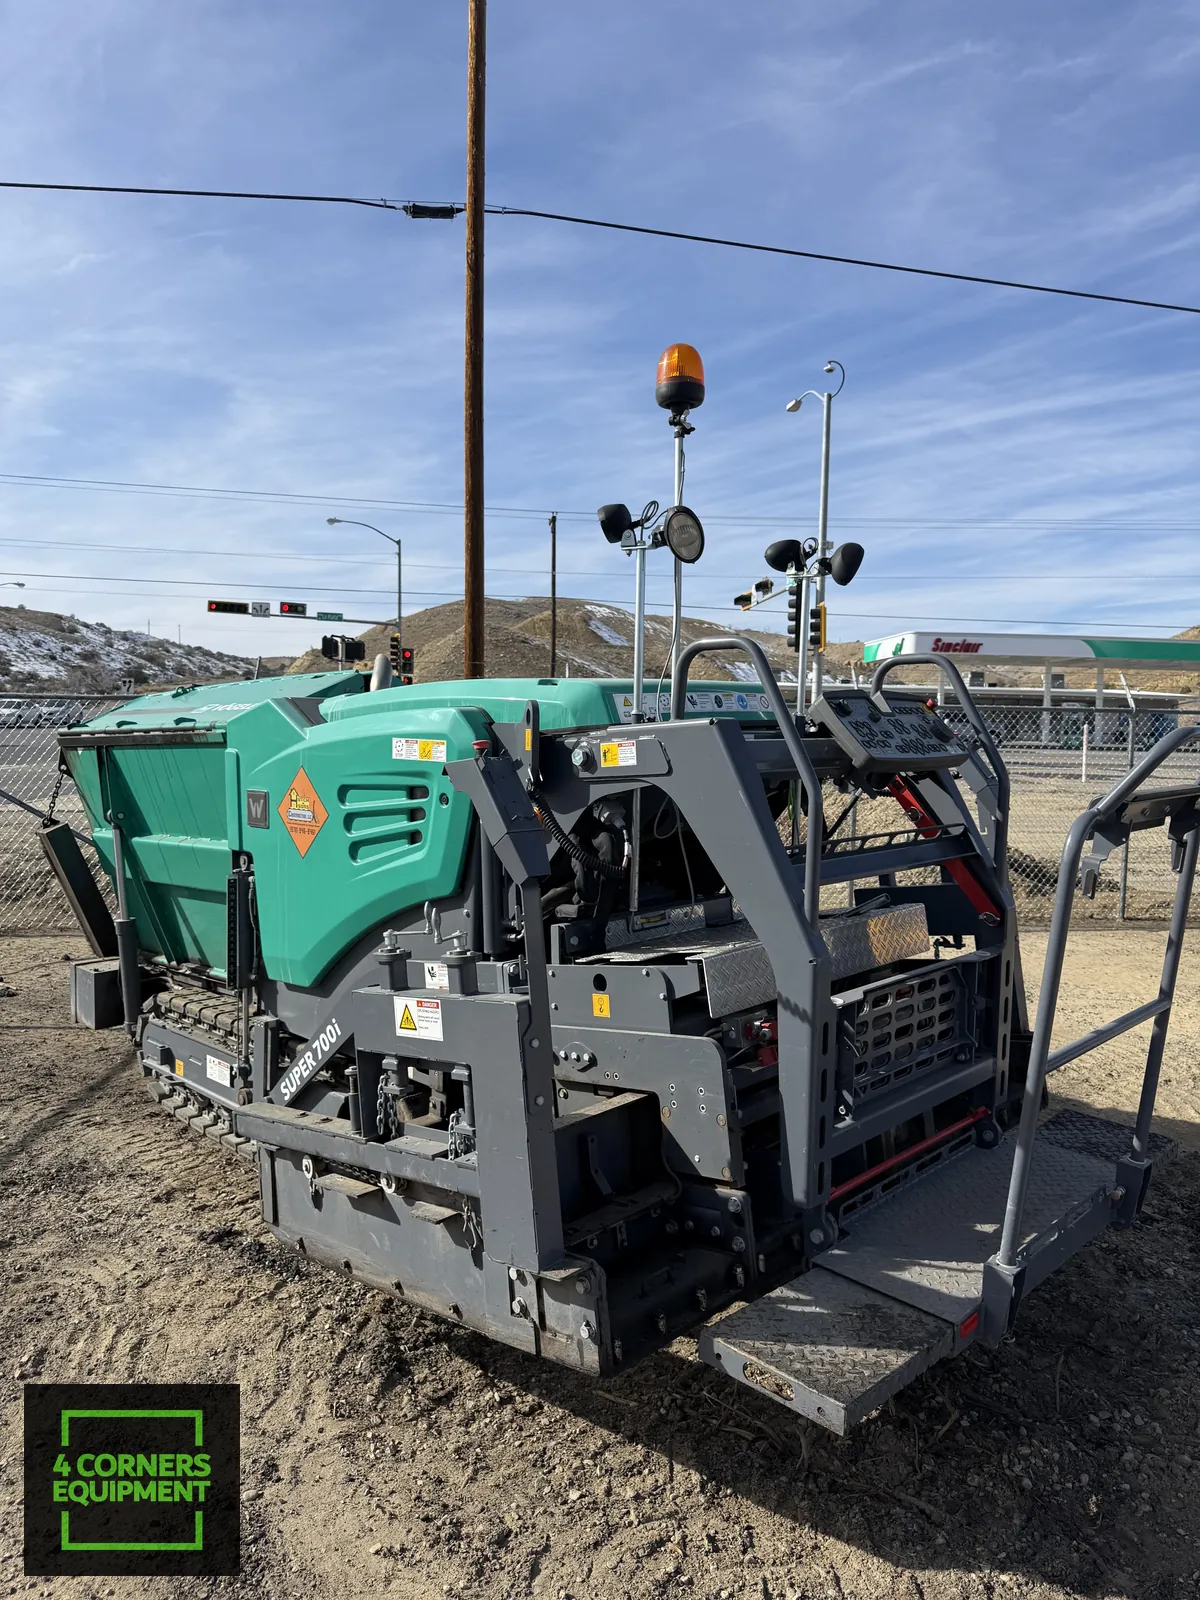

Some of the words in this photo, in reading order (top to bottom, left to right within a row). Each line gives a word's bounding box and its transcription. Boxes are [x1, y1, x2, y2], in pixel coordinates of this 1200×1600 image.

[930, 637, 984, 653] Sinclair
[248, 798, 264, 818] W
[280, 1051, 317, 1101] SUPER
[312, 1018, 341, 1060] 700i
